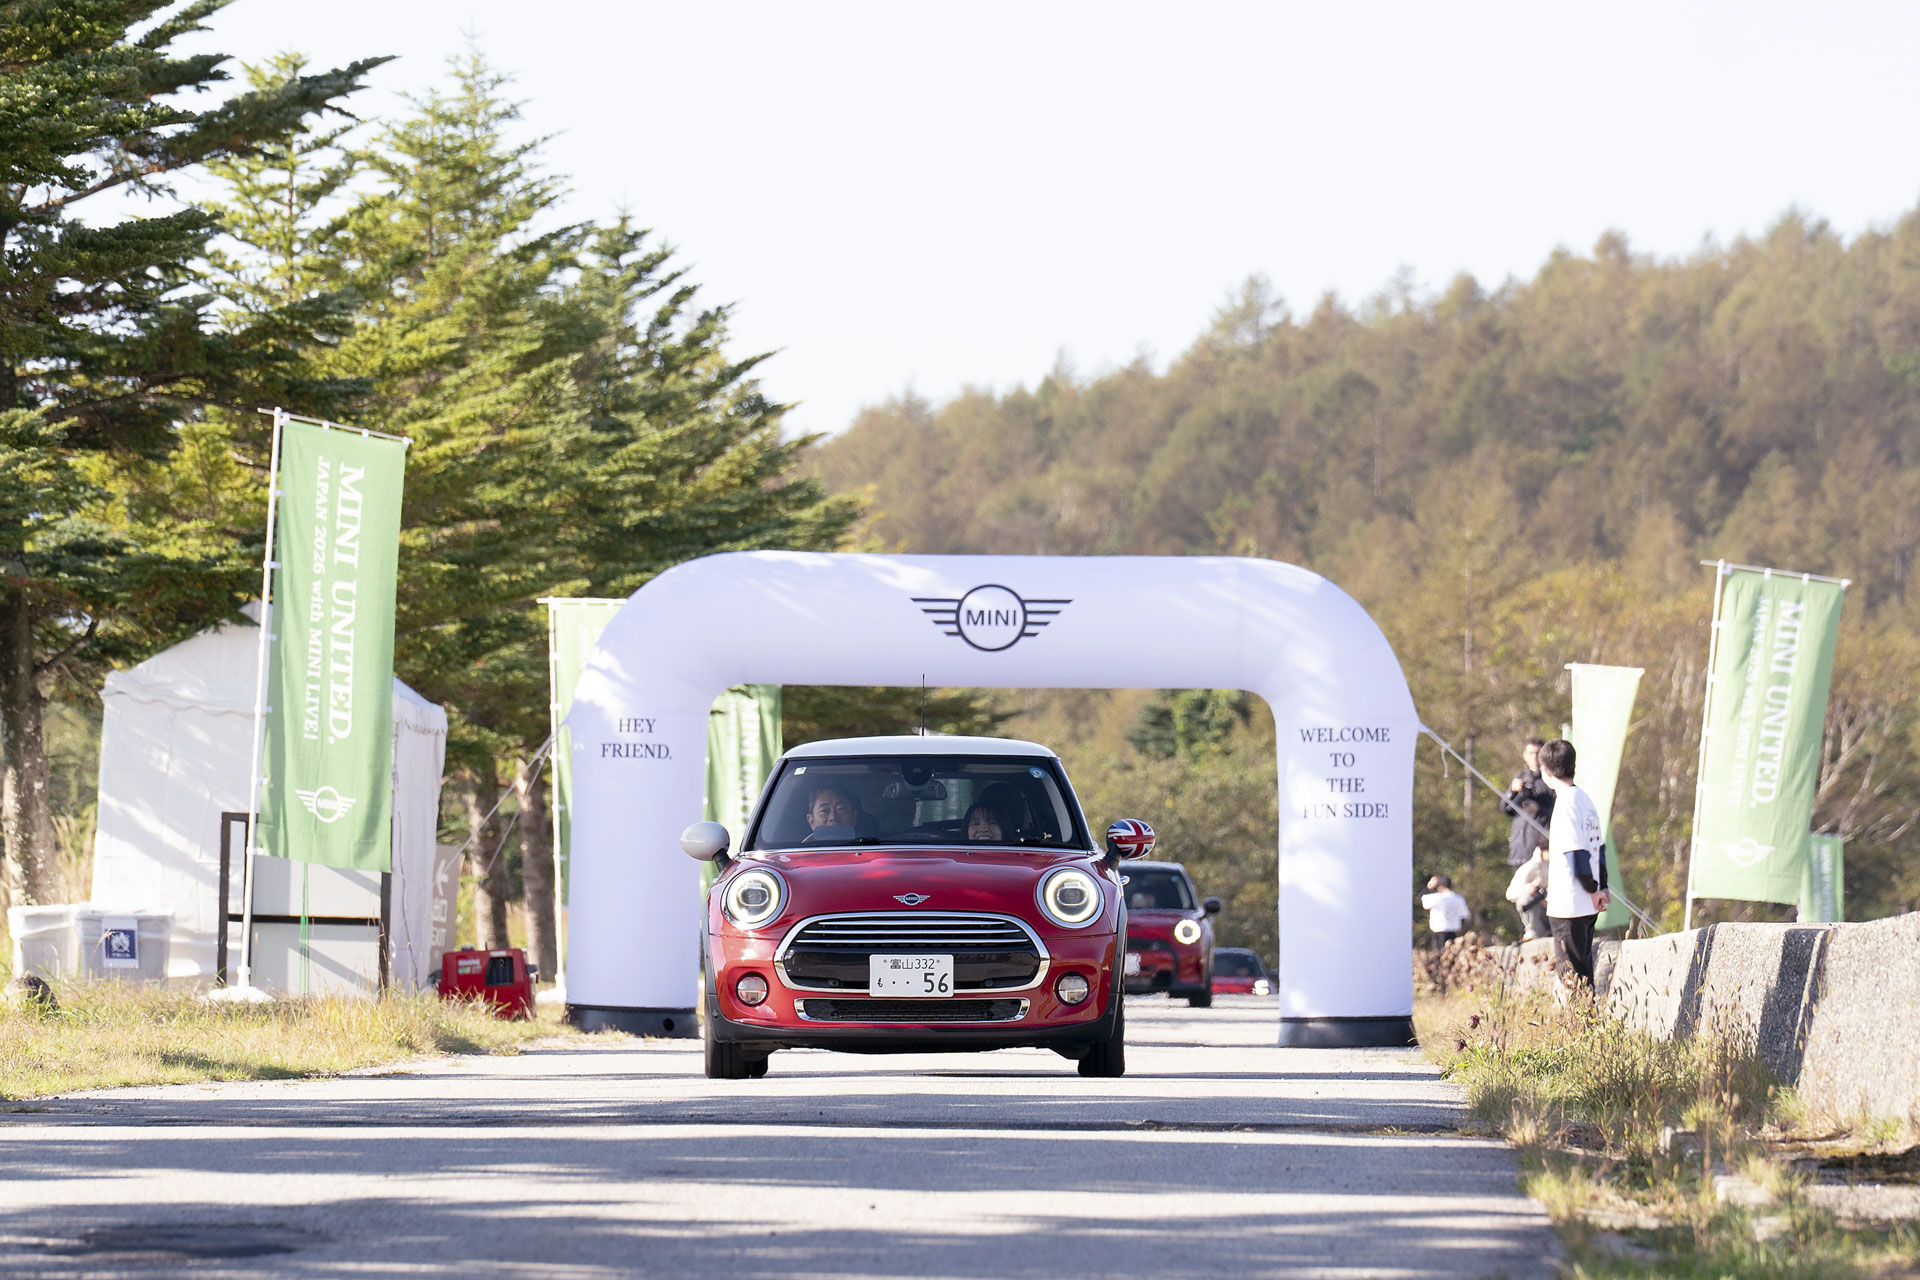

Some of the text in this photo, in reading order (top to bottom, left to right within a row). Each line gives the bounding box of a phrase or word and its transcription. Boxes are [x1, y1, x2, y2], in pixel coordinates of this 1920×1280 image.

[304, 455, 330, 740] JAPAN 2026 with MINI LIVE!
[328, 462, 365, 745] MINI UNITED.
[966, 609, 1017, 626] MINI
[1750, 599, 1805, 808] MINI UNITED.
[618, 718, 656, 733] HEY
[1299, 727, 1390, 742] WELCOME
[601, 743, 673, 760] FRIEND.
[1330, 752, 1355, 768] TO
[1326, 777, 1365, 793] THE
[1343, 803, 1389, 818] SIDE!
